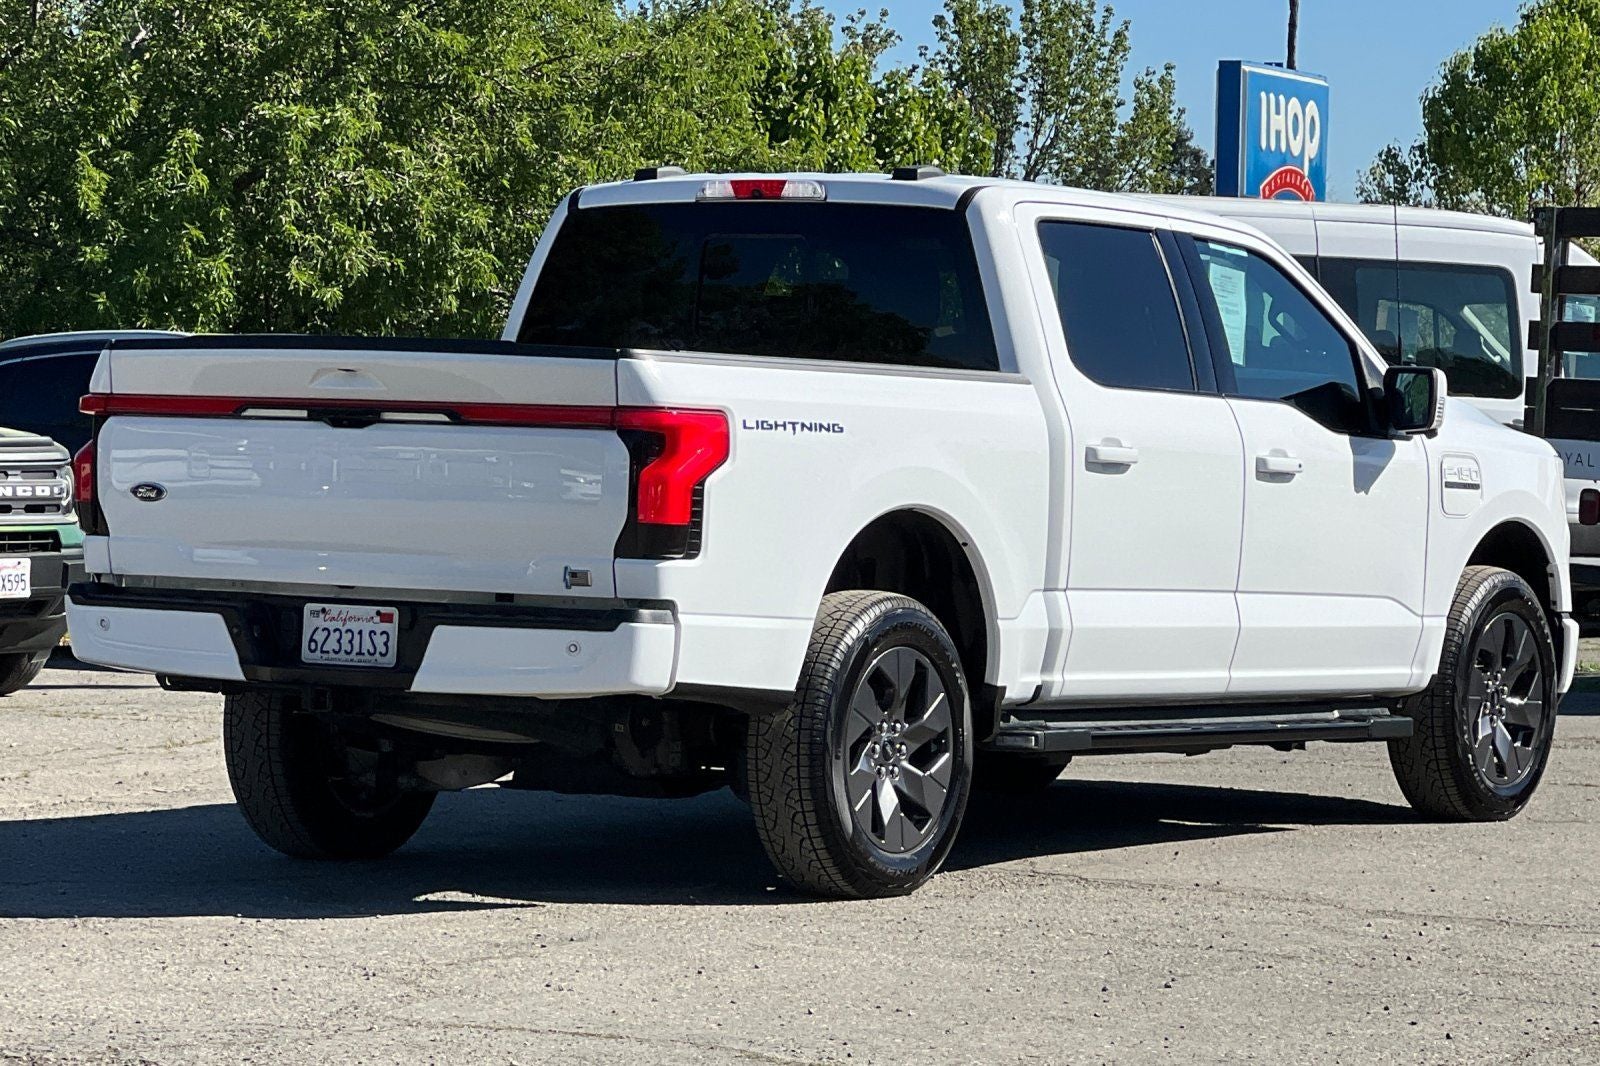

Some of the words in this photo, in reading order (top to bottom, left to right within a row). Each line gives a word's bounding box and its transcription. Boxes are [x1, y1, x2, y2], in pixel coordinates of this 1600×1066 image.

[742, 418, 845, 436] LIGHTNING
[136, 486, 158, 498] Ford
[322, 609, 374, 627] California
[307, 626, 391, 658] 62331S3
